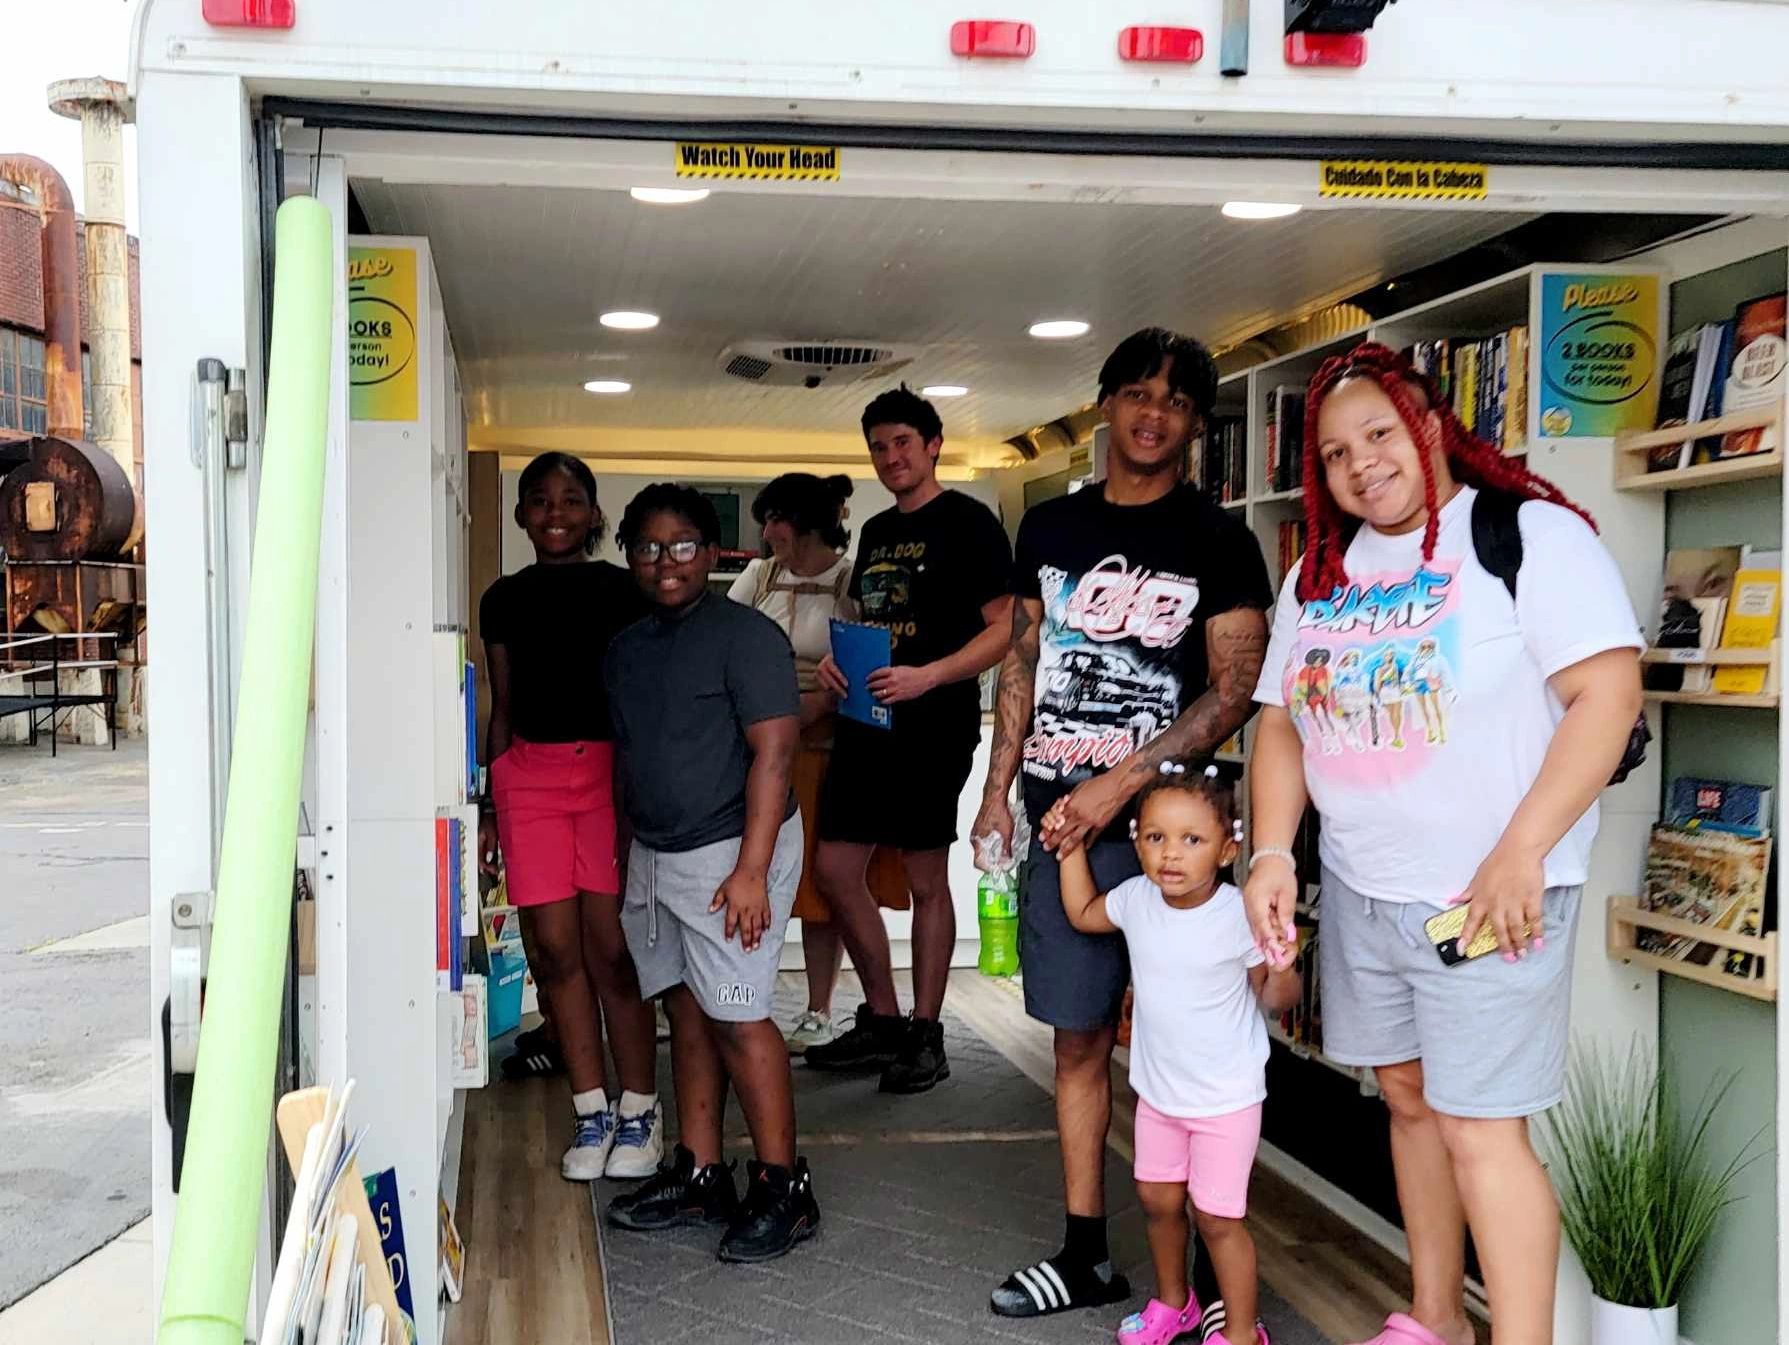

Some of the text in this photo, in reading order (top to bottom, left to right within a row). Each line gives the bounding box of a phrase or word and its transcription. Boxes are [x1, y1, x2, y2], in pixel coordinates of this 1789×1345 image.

[681, 145, 836, 169] Watch Your Head
[1325, 165, 1383, 187] Cuidado
[1386, 168, 1413, 187] Con
[1562, 283, 1639, 312] Please
[349, 321, 392, 336] OKS
[350, 342, 382, 351] erson
[350, 354, 389, 368] oday!
[716, 983, 756, 1006] GAP
